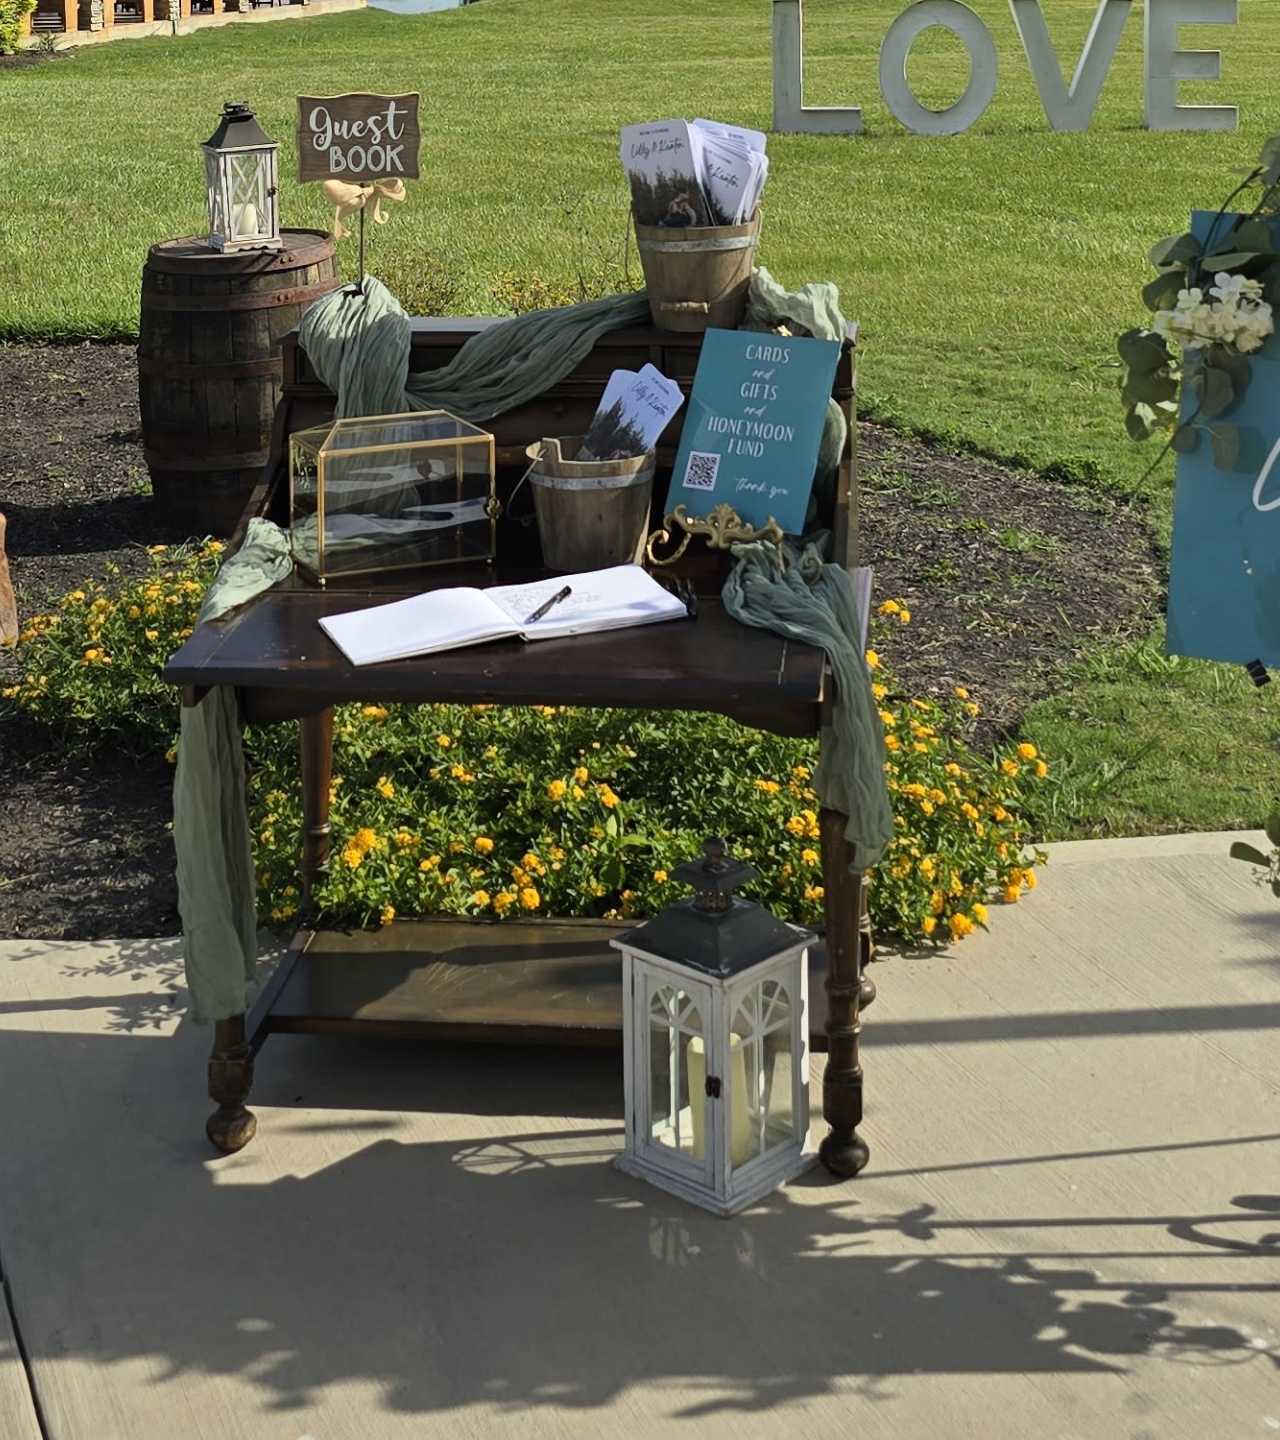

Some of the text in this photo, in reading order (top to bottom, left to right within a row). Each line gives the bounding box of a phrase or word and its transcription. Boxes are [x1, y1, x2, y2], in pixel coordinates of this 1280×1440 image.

[329, 144, 404, 173] BOOK
[745, 344, 791, 364] CARDS
[740, 382, 778, 401] GIFTS
[707, 415, 794, 442] HONEYMOON
[727, 437, 764, 458] FUND
[735, 476, 789, 499] Thank you
